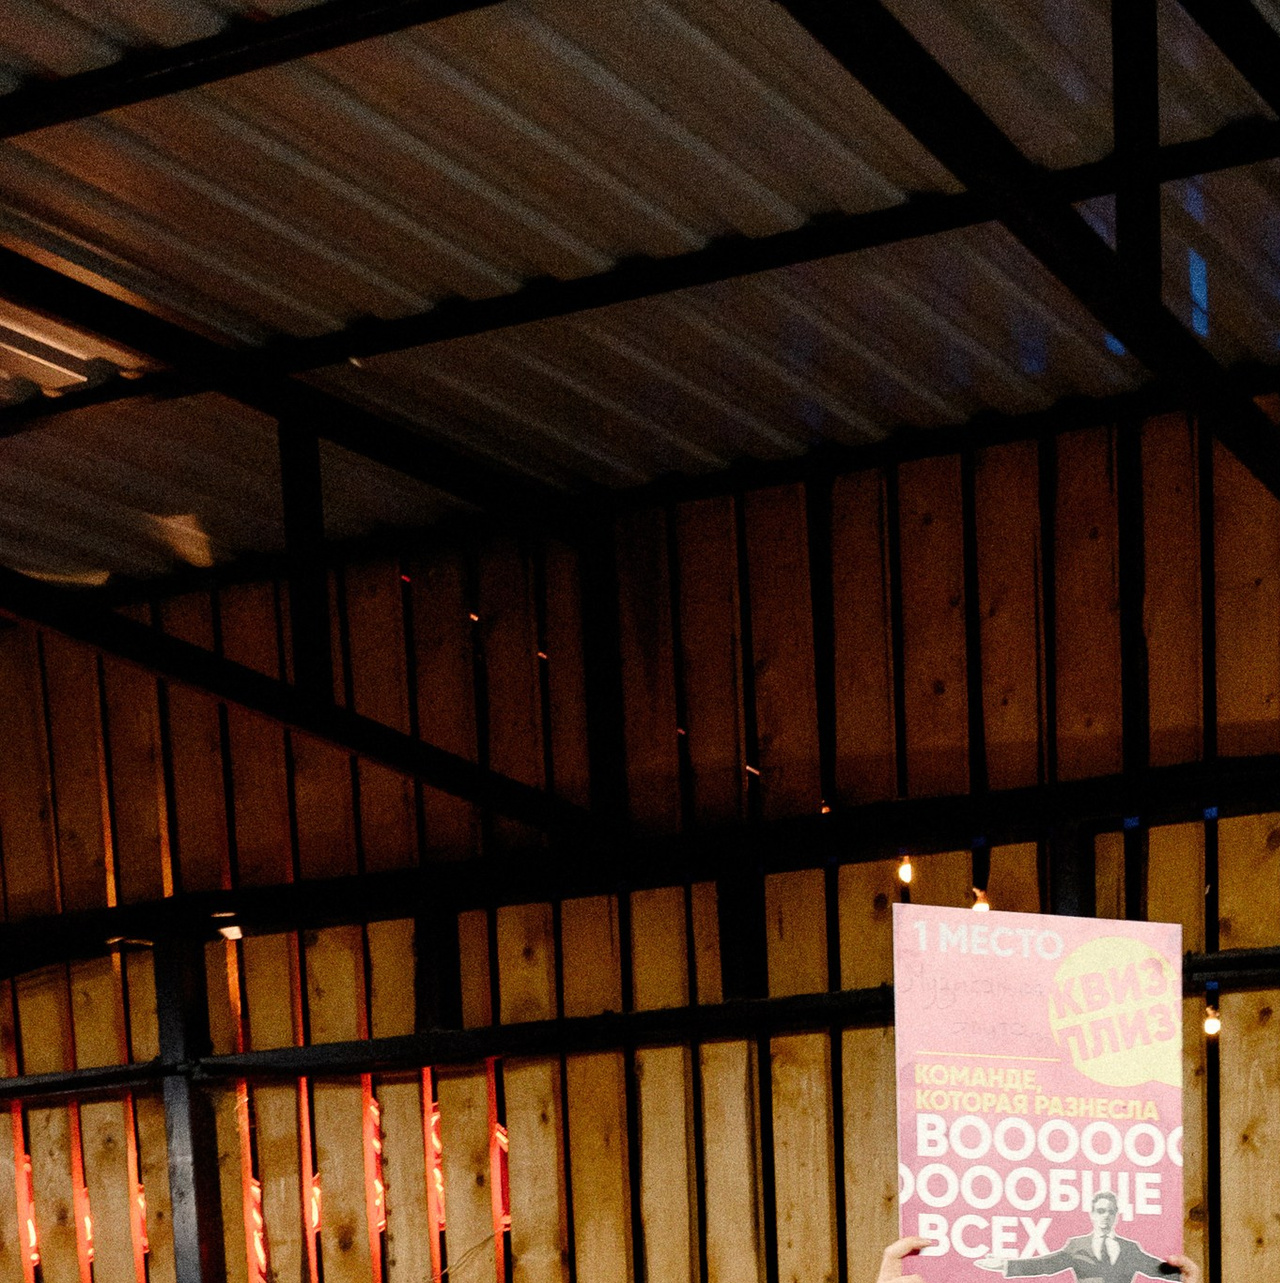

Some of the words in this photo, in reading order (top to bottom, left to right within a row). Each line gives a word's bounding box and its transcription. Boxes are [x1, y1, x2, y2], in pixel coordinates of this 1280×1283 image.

[914, 921, 927, 952] 1
[938, 922, 1064, 960] МЕСТО
[1053, 957, 1167, 1019] КВИЗ
[1057, 1004, 1176, 1061] ПЛИЗ
[914, 1063, 1043, 1095] КОМАНДЕ,
[914, 1089, 1028, 1115] КОТОРАЯ
[1034, 1095, 1160, 1121] РАЗНЕСЛА
[918, 1213, 1053, 1259] ВСЕХ
